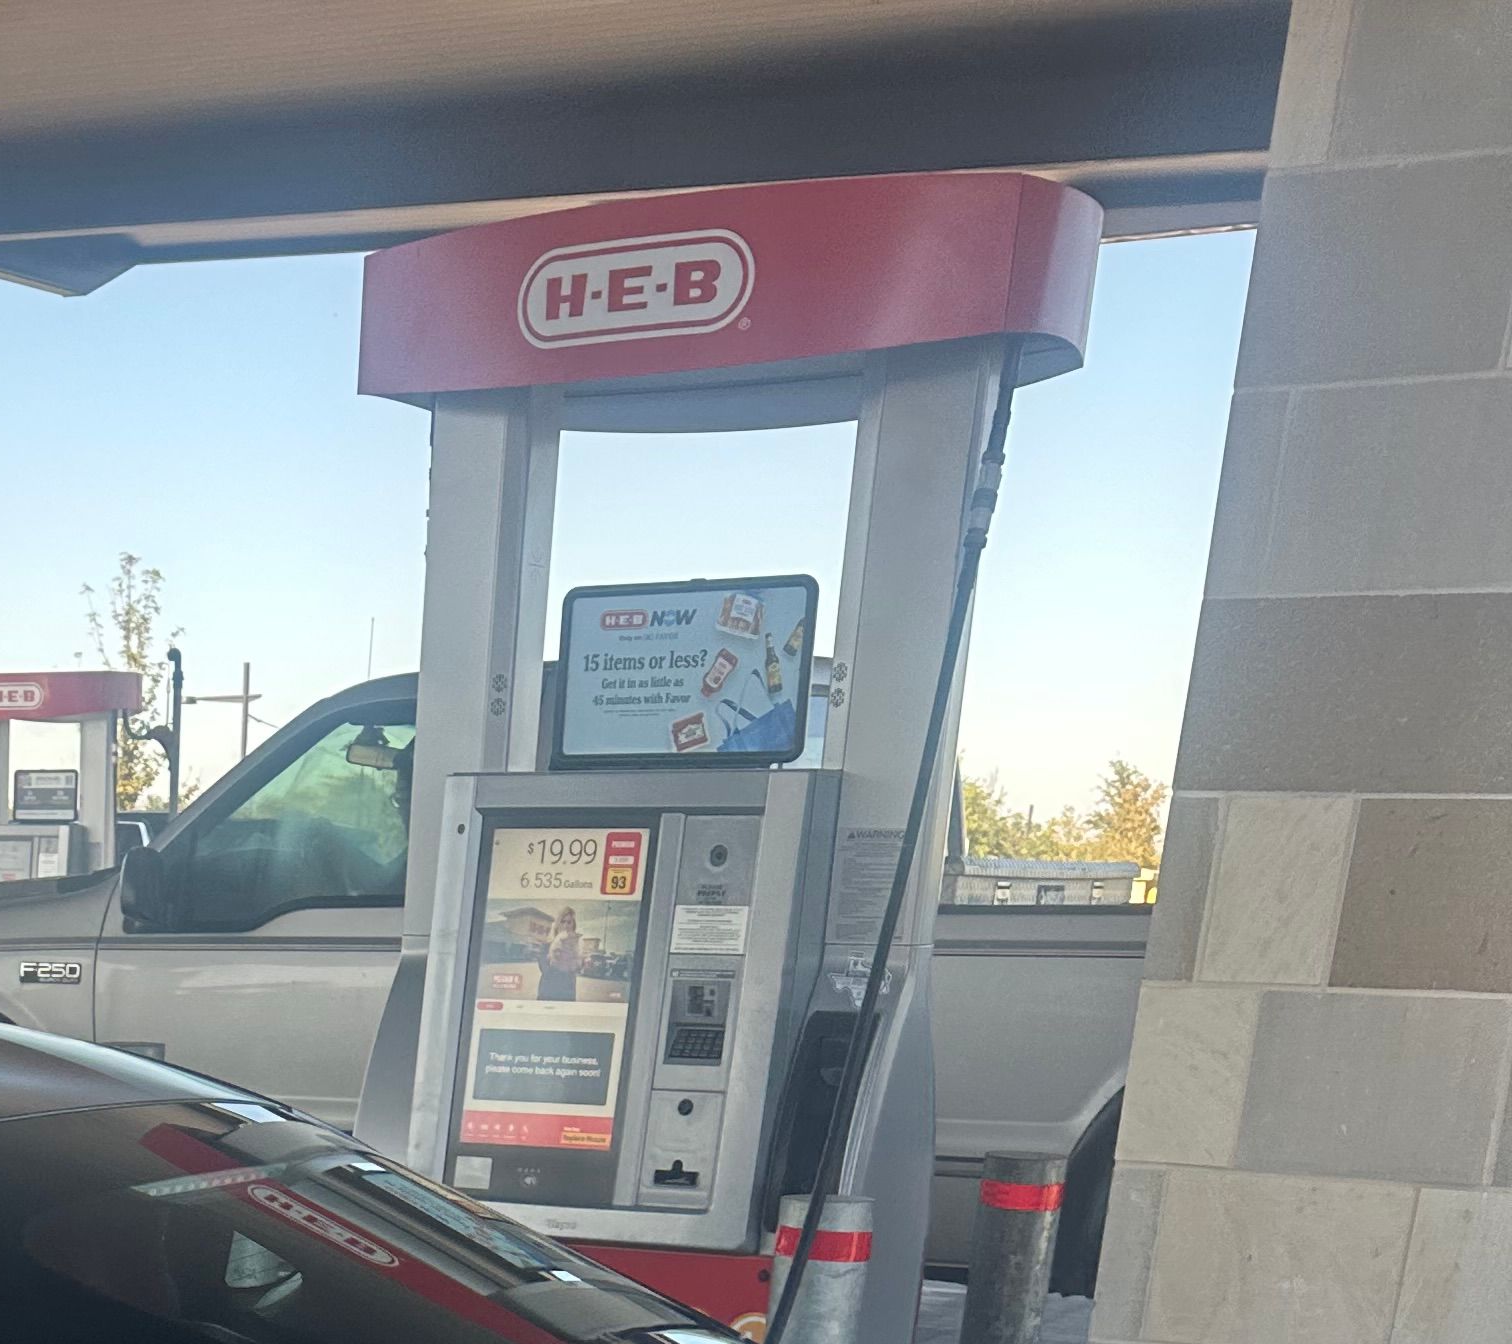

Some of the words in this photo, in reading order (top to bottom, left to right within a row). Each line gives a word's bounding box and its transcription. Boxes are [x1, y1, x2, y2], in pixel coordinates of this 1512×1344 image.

[584, 653, 600, 672] 15
[602, 653, 646, 671] items
[649, 655, 666, 669] or
[669, 649, 708, 669] less?
[601, 678, 617, 689] Get
[618, 678, 625, 689] it
[638, 679, 648, 688] as
[650, 676, 672, 688] little
[673, 678, 684, 687] as
[605, 694, 642, 705] minutes
[643, 692, 663, 704] with
[664, 692, 692, 704] Favor
[855, 829, 904, 840] WARNING
[527, 838, 598, 866] $19.99
[563, 879, 593, 889] Gallons
[610, 875, 627, 890] 93
[489, 1052, 513, 1062] Thank
[514, 1055, 529, 1065] you
[531, 1054, 542, 1062] for
[543, 1056, 561, 1065] your
[485, 1065, 510, 1074] please
[511, 1066, 534, 1074] come
[534, 1066, 554, 1075] back
[555, 1068, 577, 1078] again
